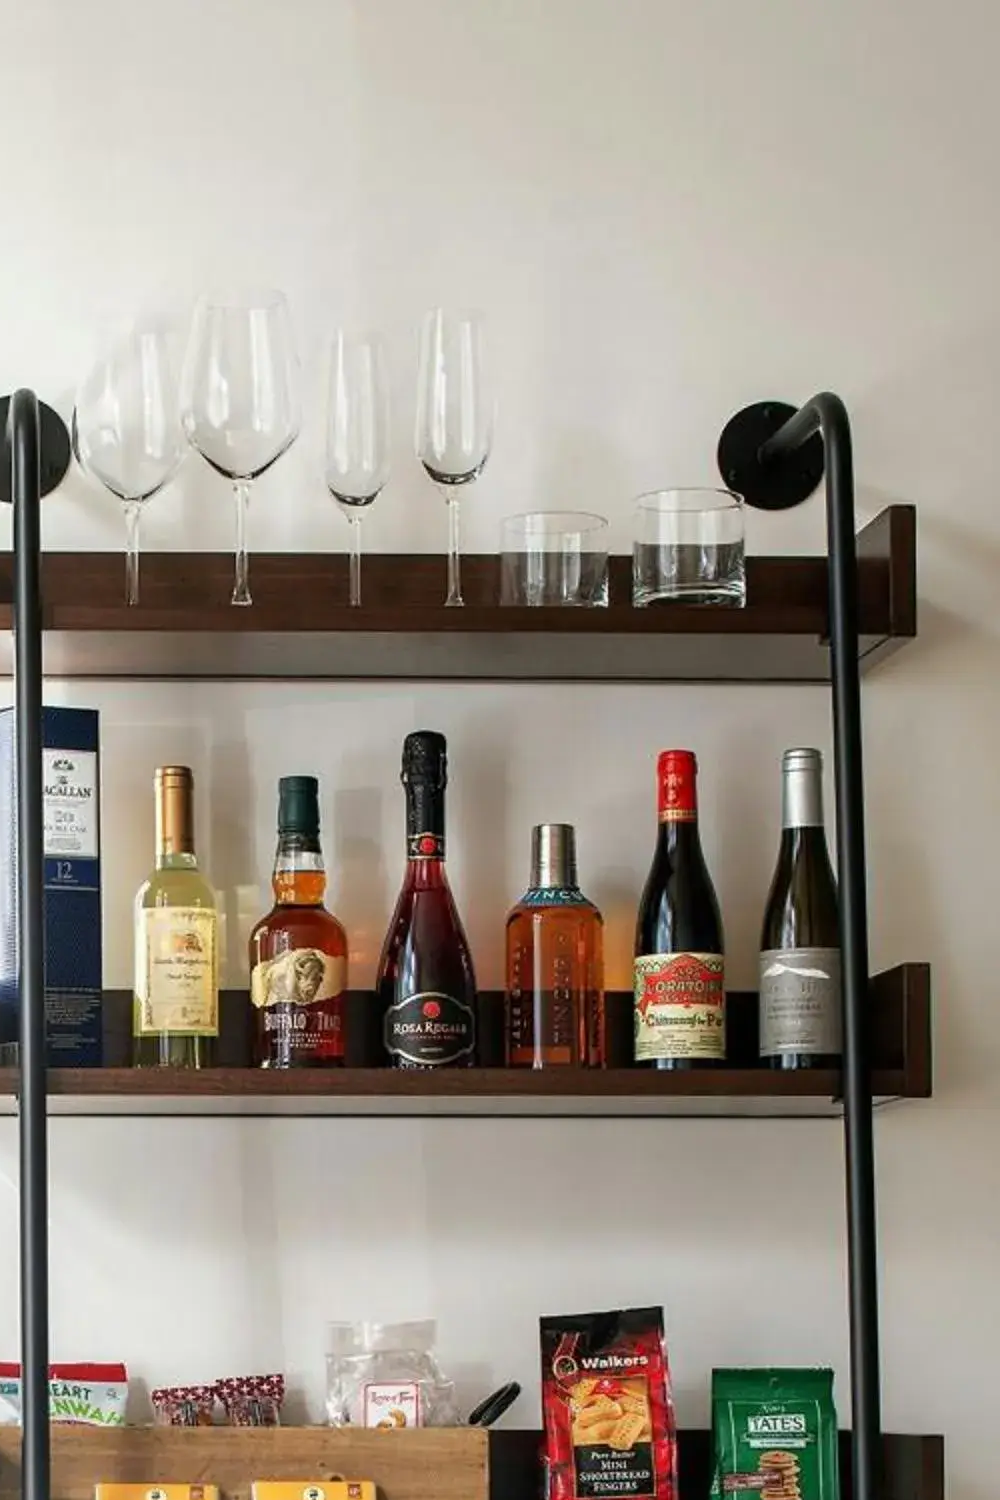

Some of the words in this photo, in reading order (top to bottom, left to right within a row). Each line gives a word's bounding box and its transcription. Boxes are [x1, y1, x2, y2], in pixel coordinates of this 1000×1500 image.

[43, 785, 92, 797] ACALLAN
[56, 861, 73, 879] 12
[264, 1012, 307, 1031] BUFFALO
[393, 1023, 423, 1034] ROSA
[425, 1022, 467, 1034] REGALE
[582, 1355, 649, 1370] Walkers
[50, 1383, 91, 1400] EART
[600, 1460, 627, 1470] MINI
[579, 1471, 650, 1482] SHORTBREAD
[593, 1482, 639, 1492] FINGERS
